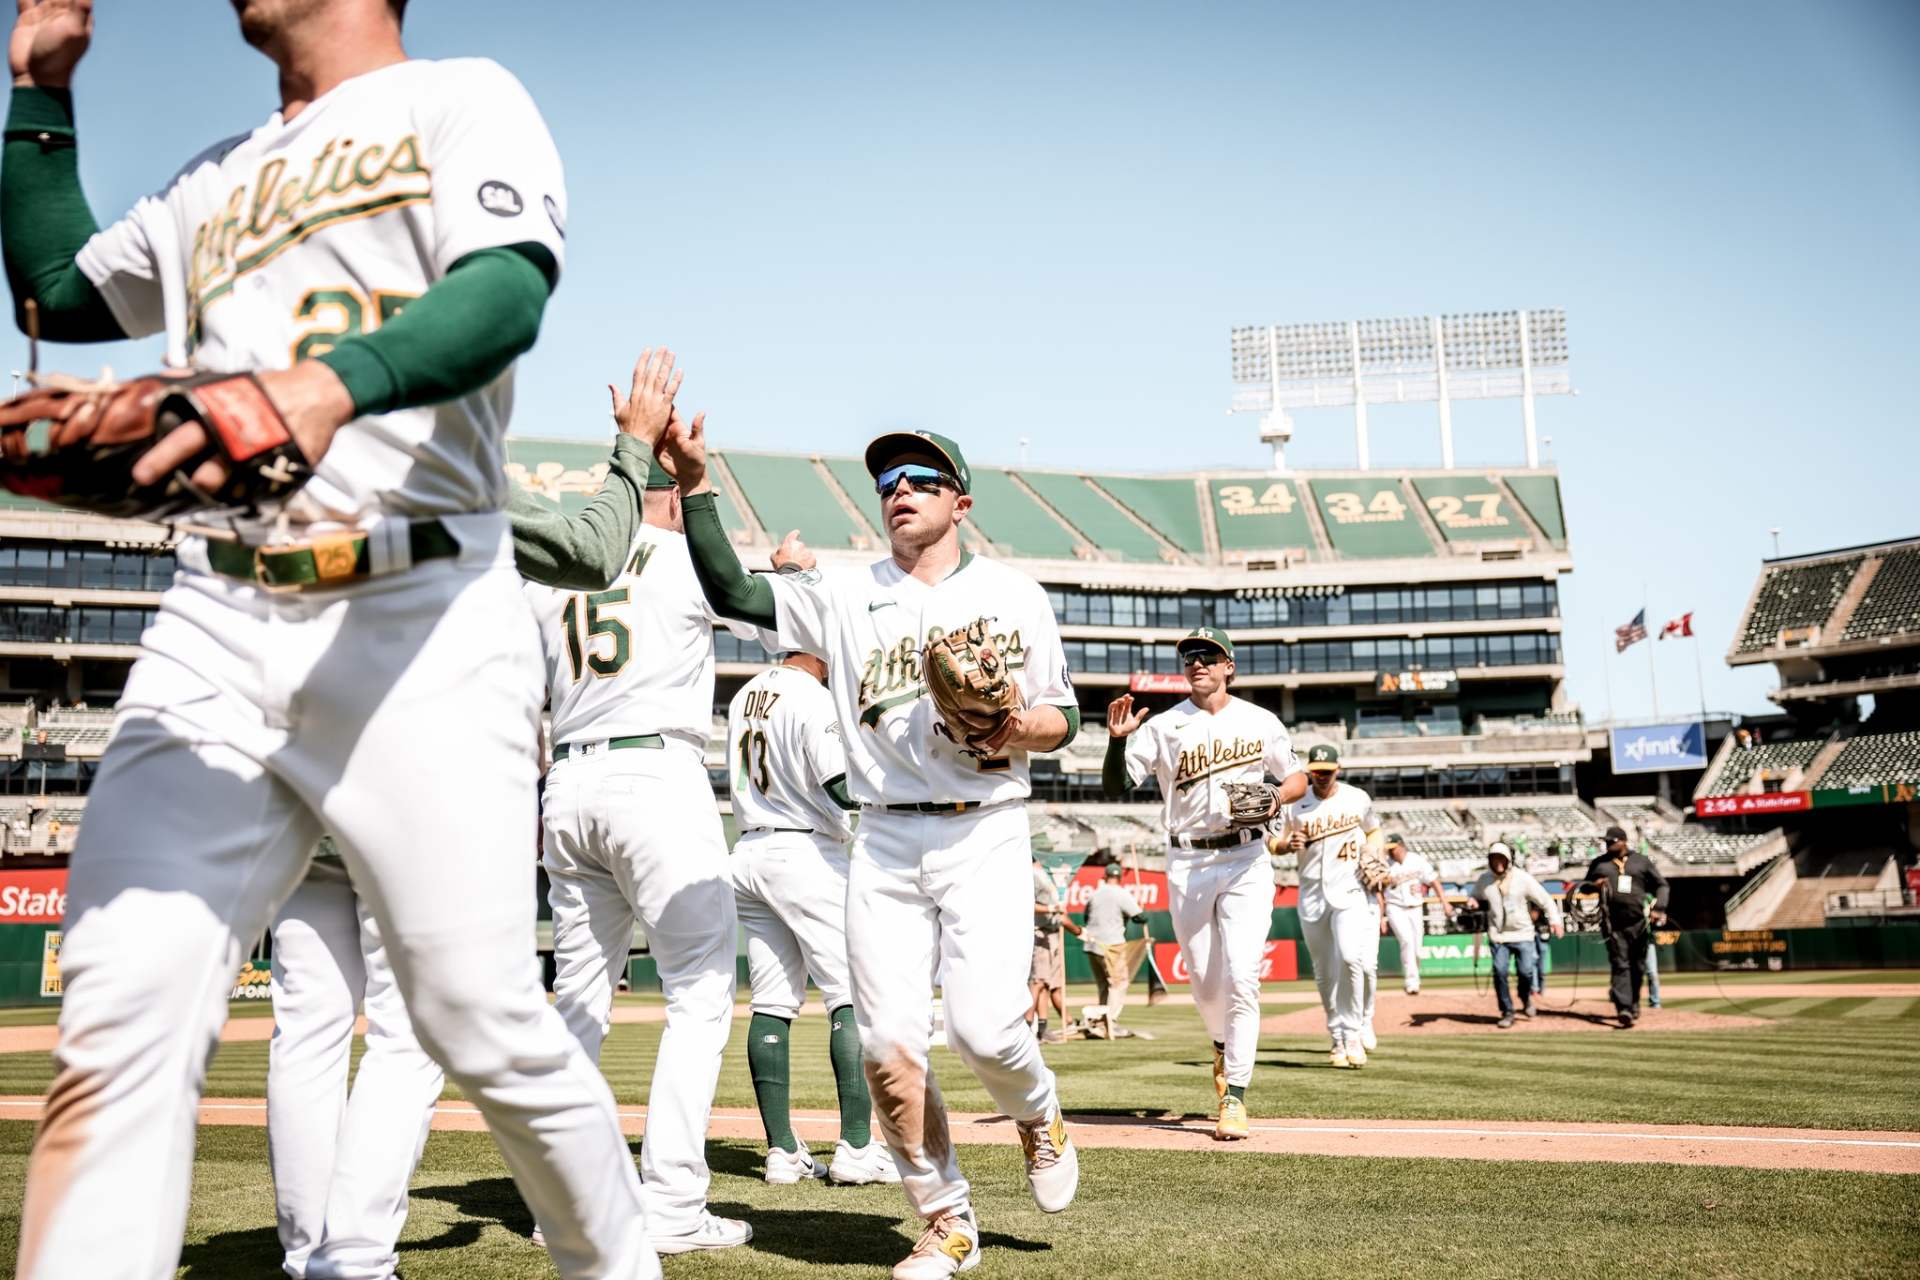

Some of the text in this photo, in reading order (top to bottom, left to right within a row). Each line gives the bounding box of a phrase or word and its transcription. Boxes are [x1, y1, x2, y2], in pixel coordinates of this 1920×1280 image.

[1219, 483, 1297, 509] 34
[1324, 490, 1407, 516] 34
[1427, 493, 1503, 521] 27
[561, 585, 631, 684] 15
[743, 690, 780, 720] DIAZ
[738, 730, 770, 795] 13
[1175, 737, 1263, 781] Athletics
[1624, 736, 1692, 762] xfinity
